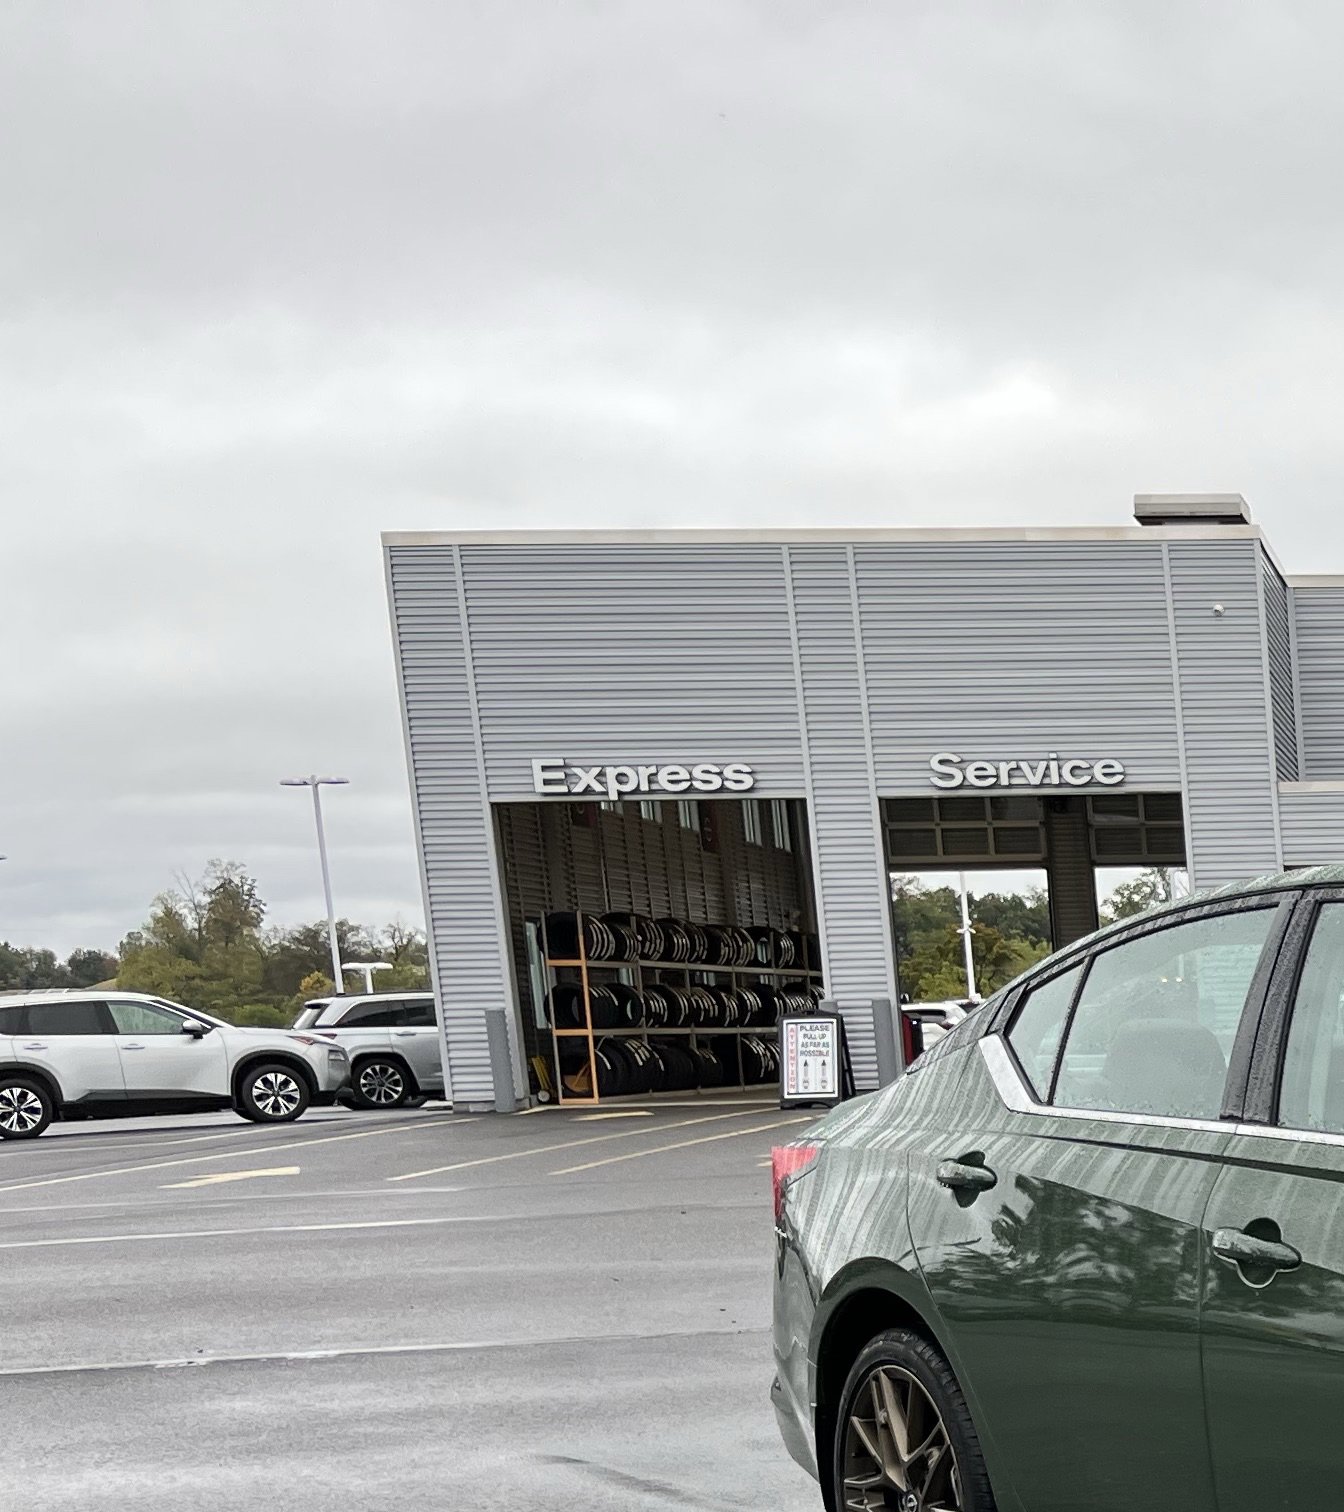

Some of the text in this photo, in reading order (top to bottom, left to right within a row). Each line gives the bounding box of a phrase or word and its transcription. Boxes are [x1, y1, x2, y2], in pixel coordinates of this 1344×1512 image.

[531, 757, 755, 800] Express
[929, 752, 1126, 788] Service
[801, 1041, 830, 1049] AS FAR AS
